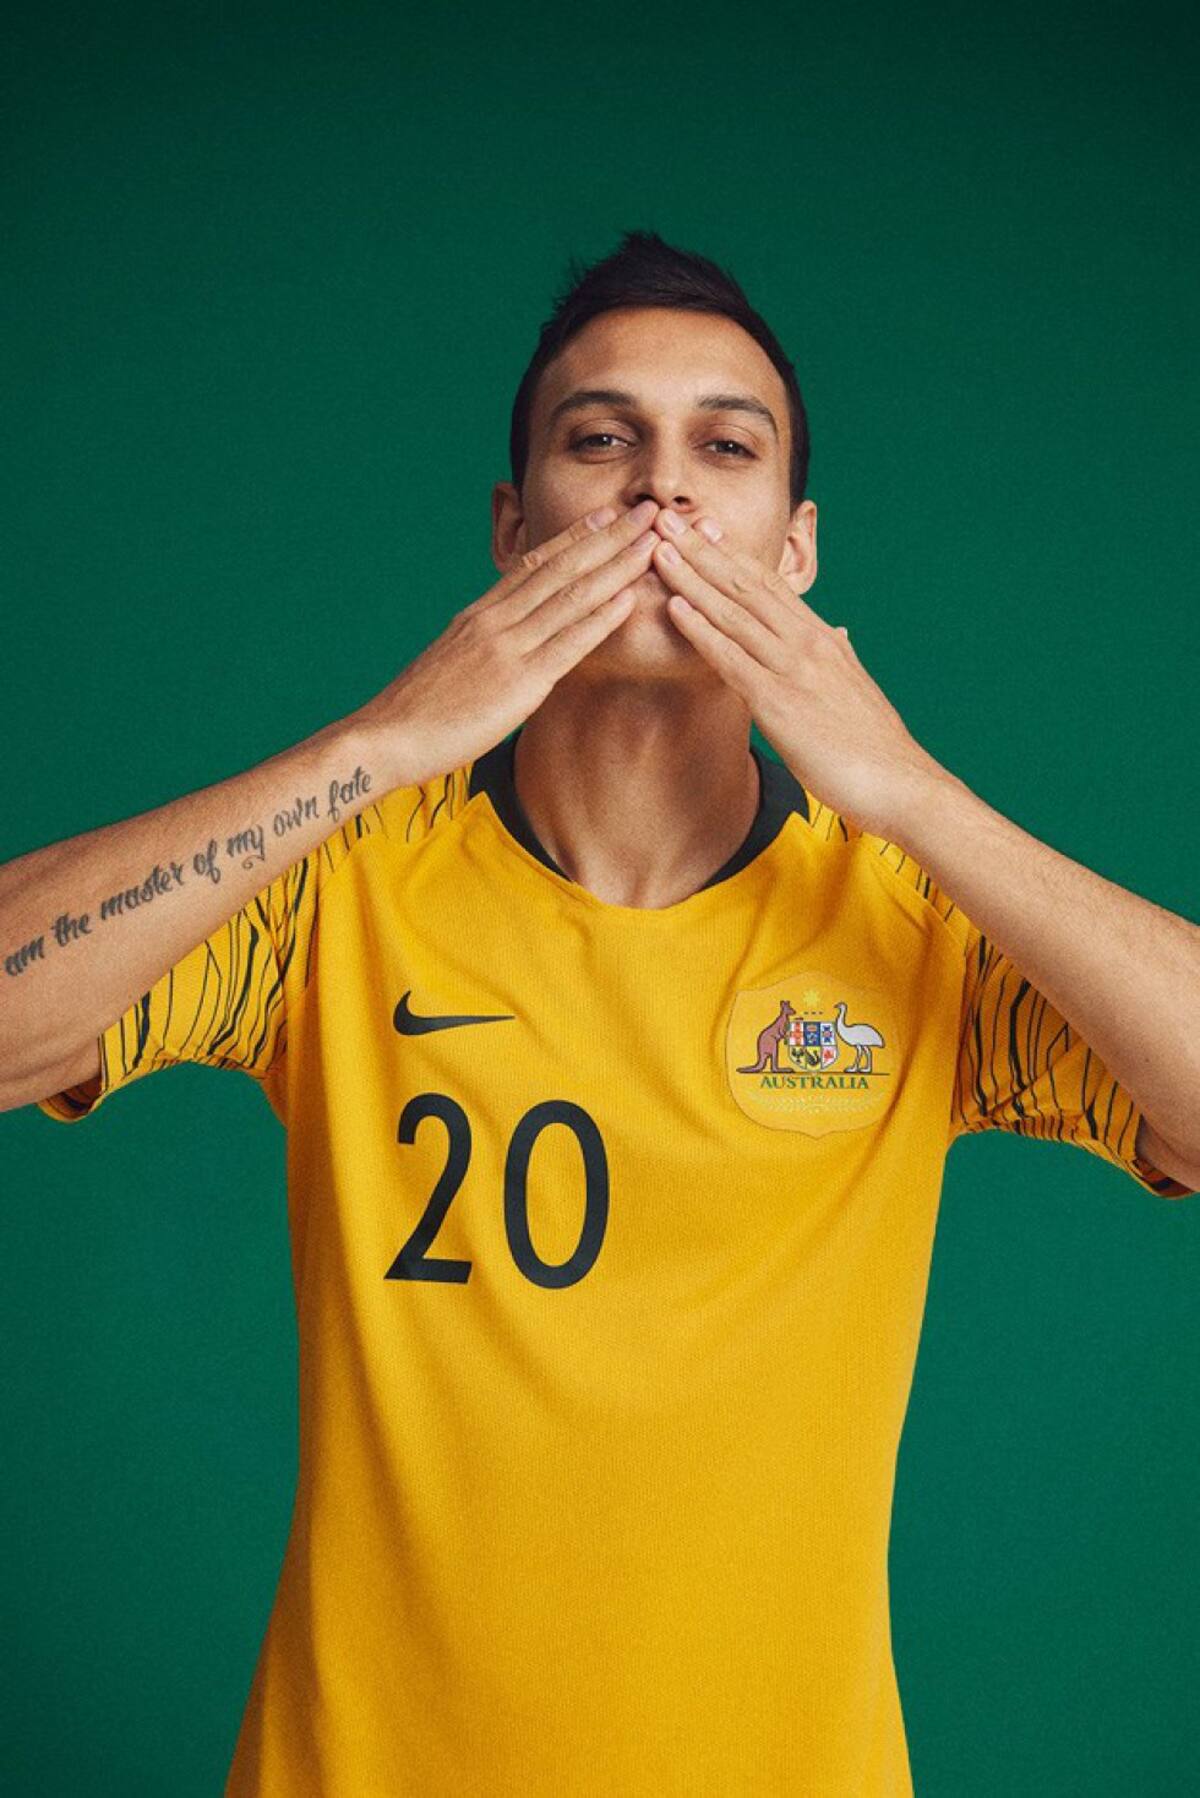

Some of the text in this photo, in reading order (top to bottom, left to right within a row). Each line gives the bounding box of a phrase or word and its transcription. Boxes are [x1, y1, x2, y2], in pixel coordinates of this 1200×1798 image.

[4, 766, 372, 976] am the master of my own fate
[760, 1076, 869, 1089] AUSTRALIA
[384, 1092, 609, 1289] 20
